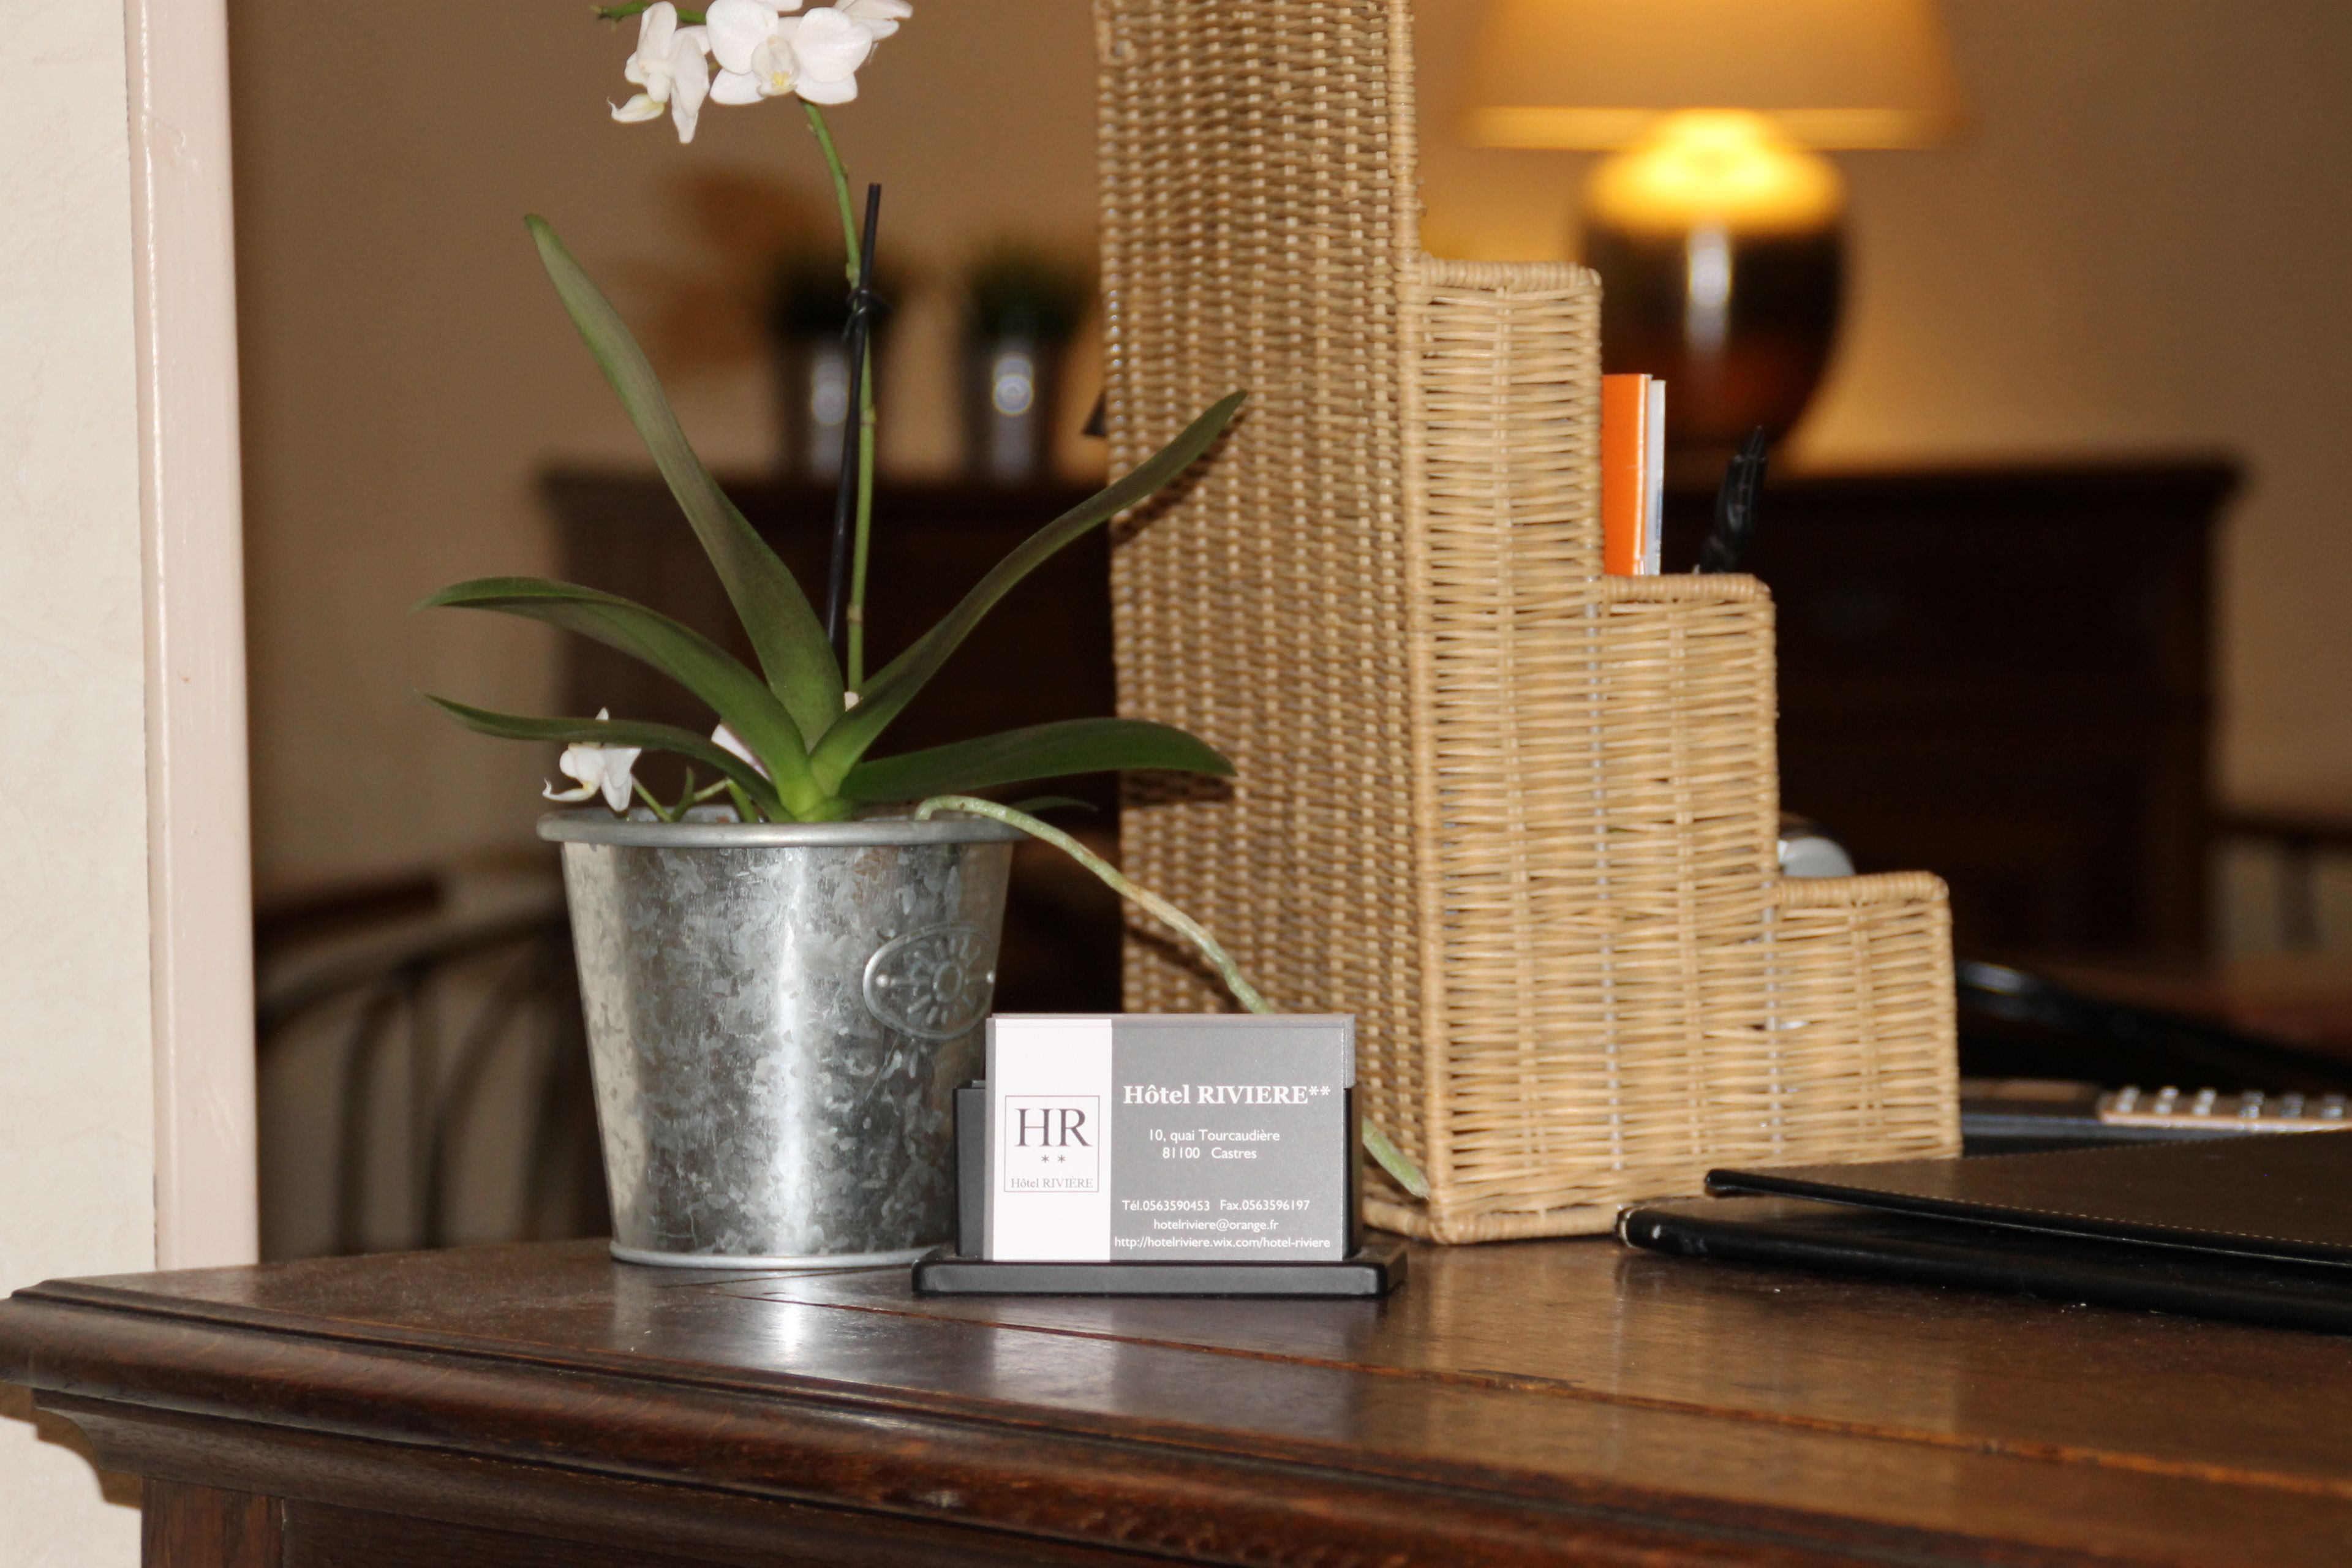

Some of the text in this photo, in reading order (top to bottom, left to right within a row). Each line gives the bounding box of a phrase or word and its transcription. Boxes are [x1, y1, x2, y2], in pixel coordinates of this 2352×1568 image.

[1123, 1084, 1191, 1104] Hôtel
[1015, 1107, 1093, 1147] HR
[1149, 1128, 1280, 1144] 10, quai Tourcaudière
[1162, 1147, 1257, 1159] 81100 Castres
[1011, 1176, 1093, 1188] Hôtel RIVIÈRE
[1121, 1199, 1310, 1212] Tél.0563590453 Fax.0563596197
[1153, 1218, 1279, 1233] hotelriviere@orange.fr
[1115, 1236, 1330, 1250] http://hotelriviere.wix.com/hotel-riviere
